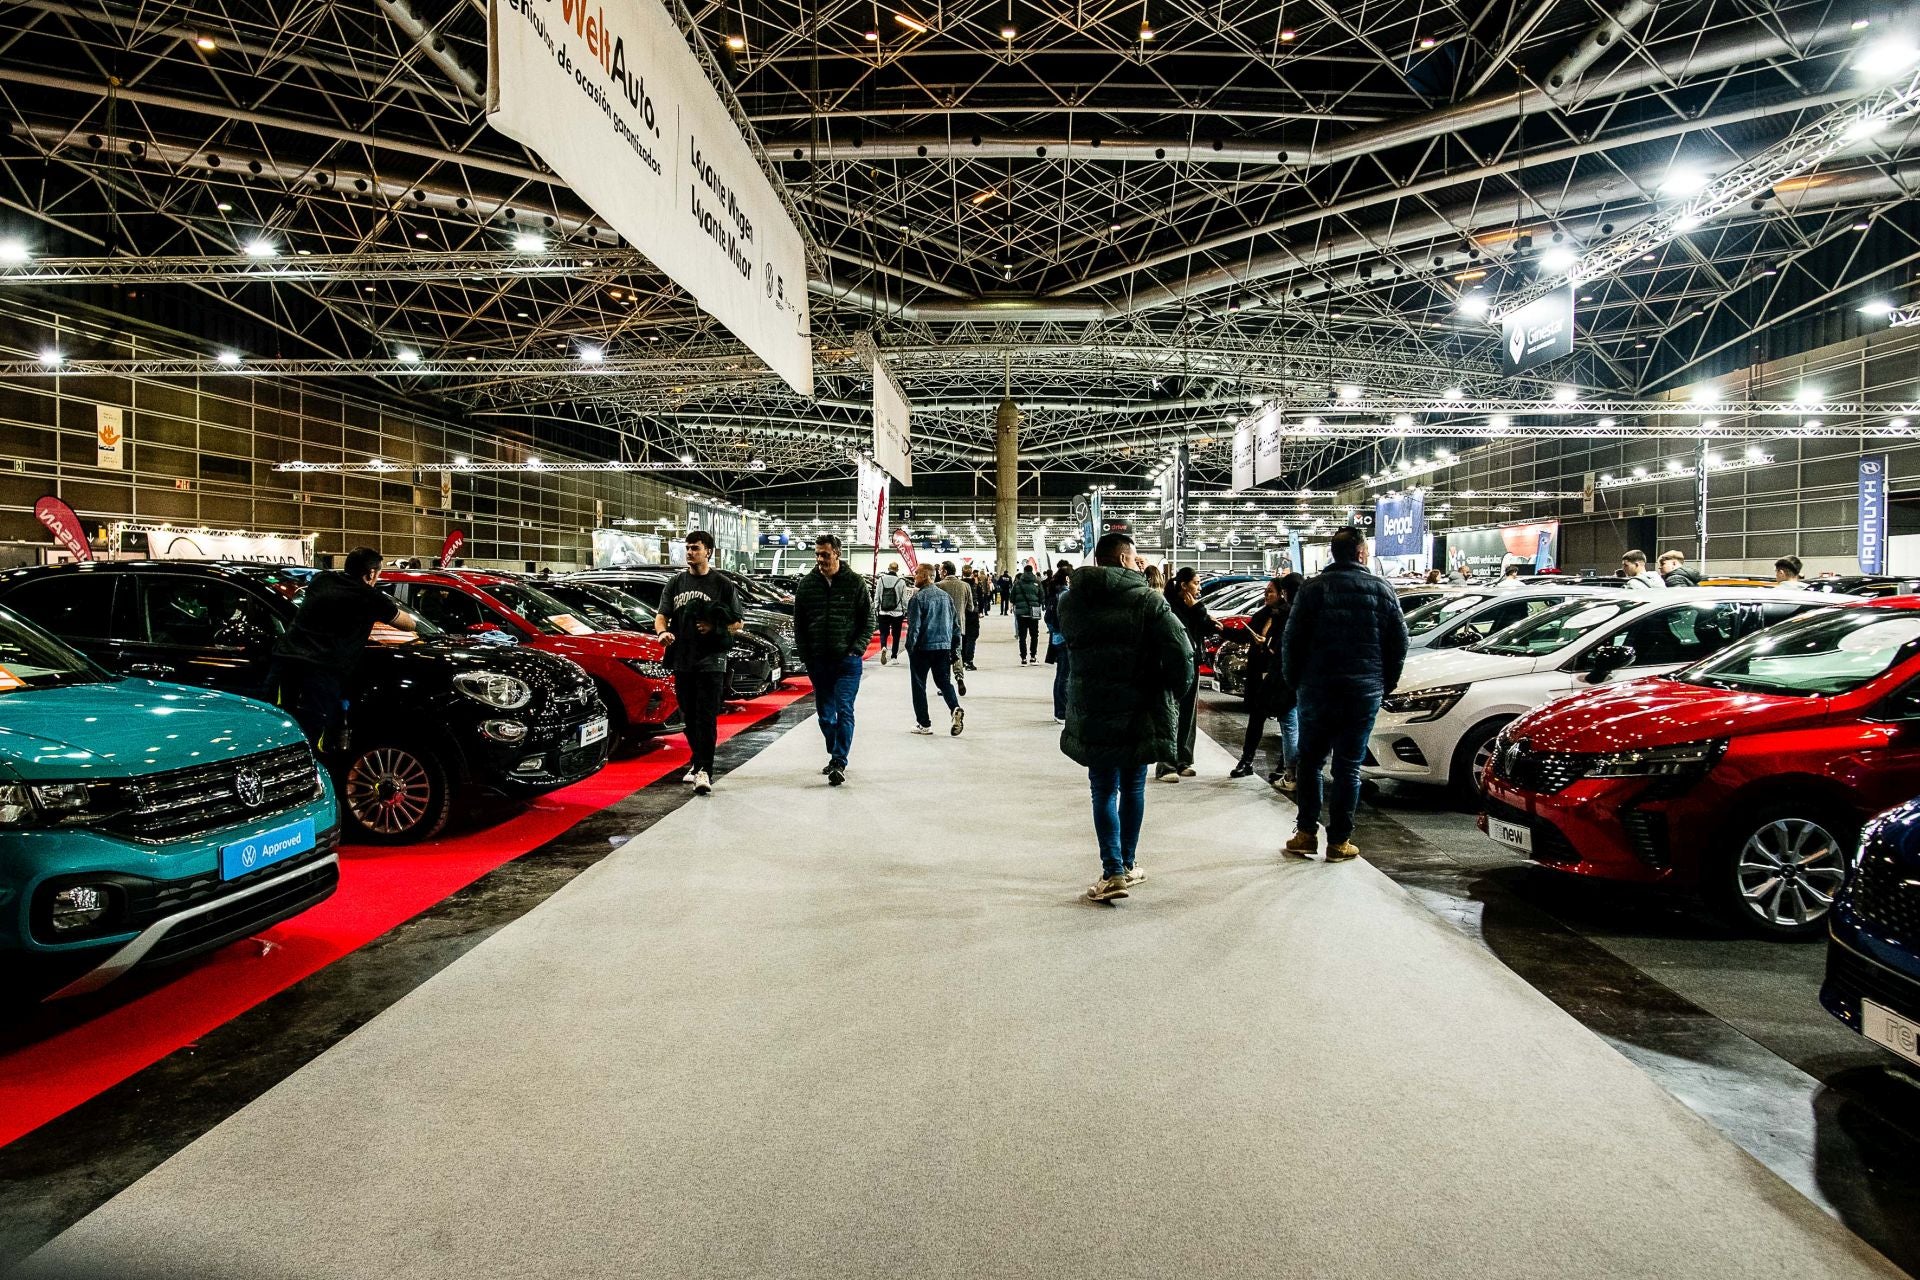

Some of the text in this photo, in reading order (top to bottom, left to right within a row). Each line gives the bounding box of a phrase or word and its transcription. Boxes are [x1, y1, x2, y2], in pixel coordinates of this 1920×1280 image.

[557, 43, 572, 75] de
[575, 68, 612, 120] ocasión
[613, 112, 662, 176] garantizados
[690, 135, 754, 245] Levante Wagen
[690, 184, 752, 281] Levante Motor
[904, 509, 911, 518] B
[262, 832, 302, 857] Approved
[1885, 1018, 1920, 1058] re
